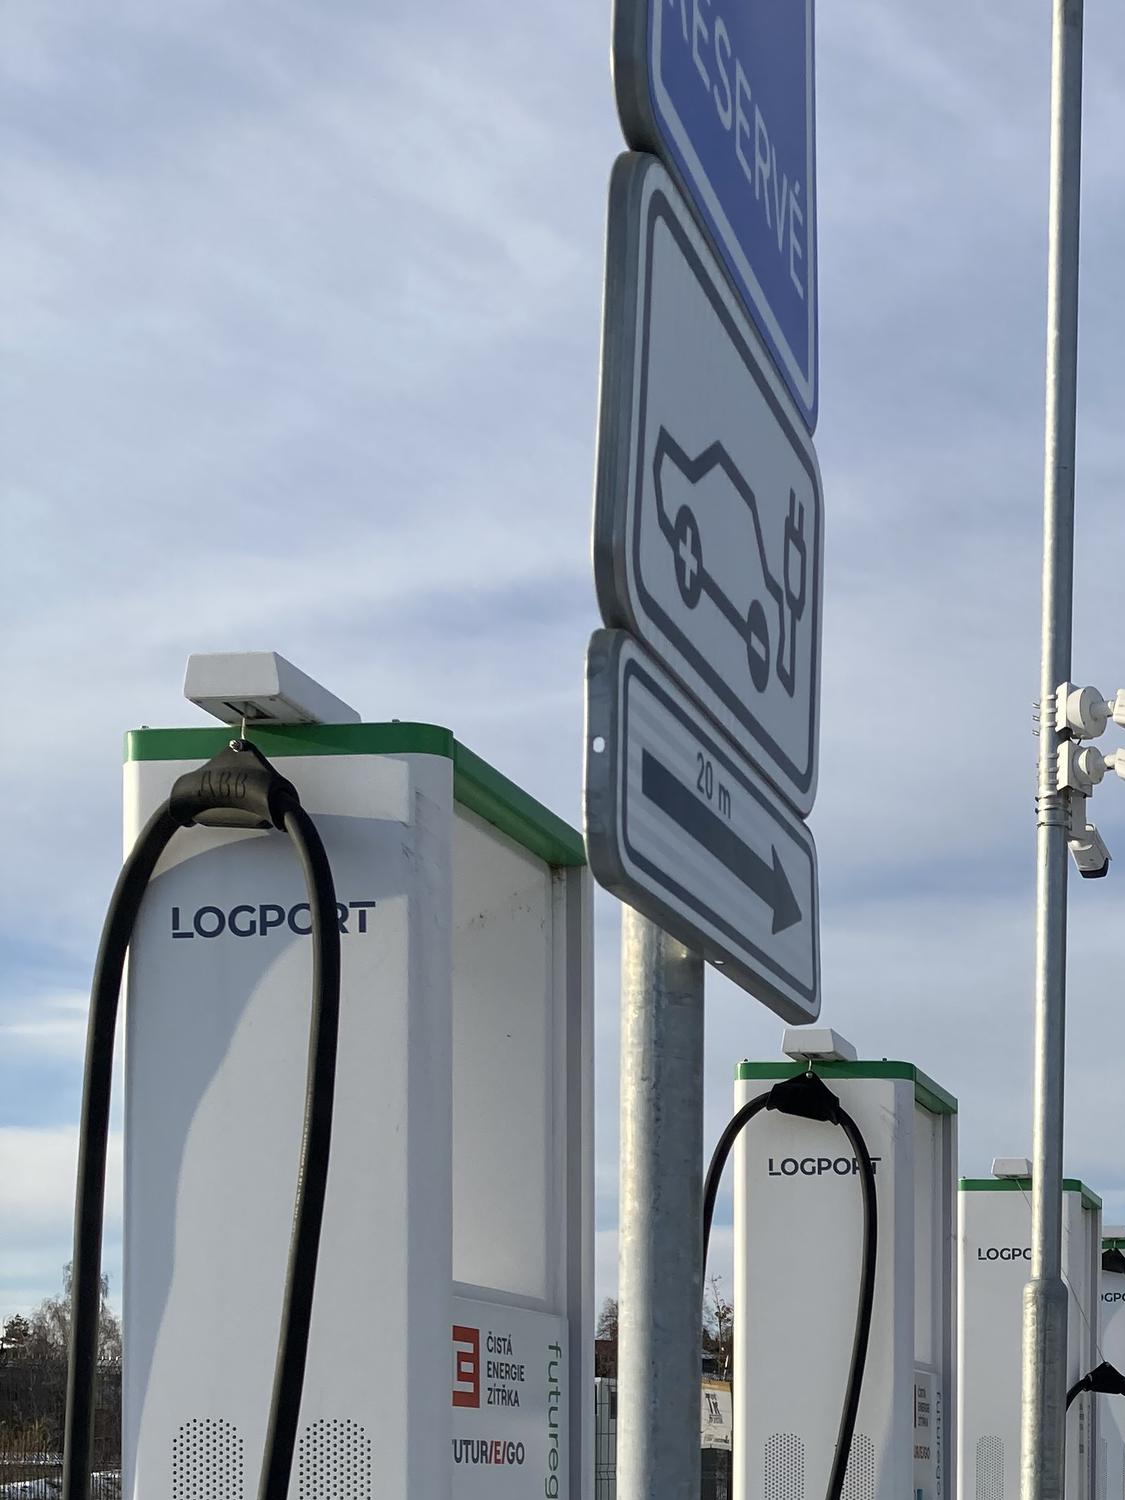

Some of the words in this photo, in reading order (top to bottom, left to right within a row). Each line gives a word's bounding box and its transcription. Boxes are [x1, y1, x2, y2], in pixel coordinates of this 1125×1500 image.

[198, 770, 248, 798] ABB
[697, 752, 713, 800] 20
[719, 782, 731, 819] m
[487, 1331, 513, 1355] ČISTÁ
[487, 1361, 525, 1382] ENERGIE
[487, 1384, 520, 1407] ZÍTŘKA
[452, 1439, 525, 1464] UTUR/E/GO
